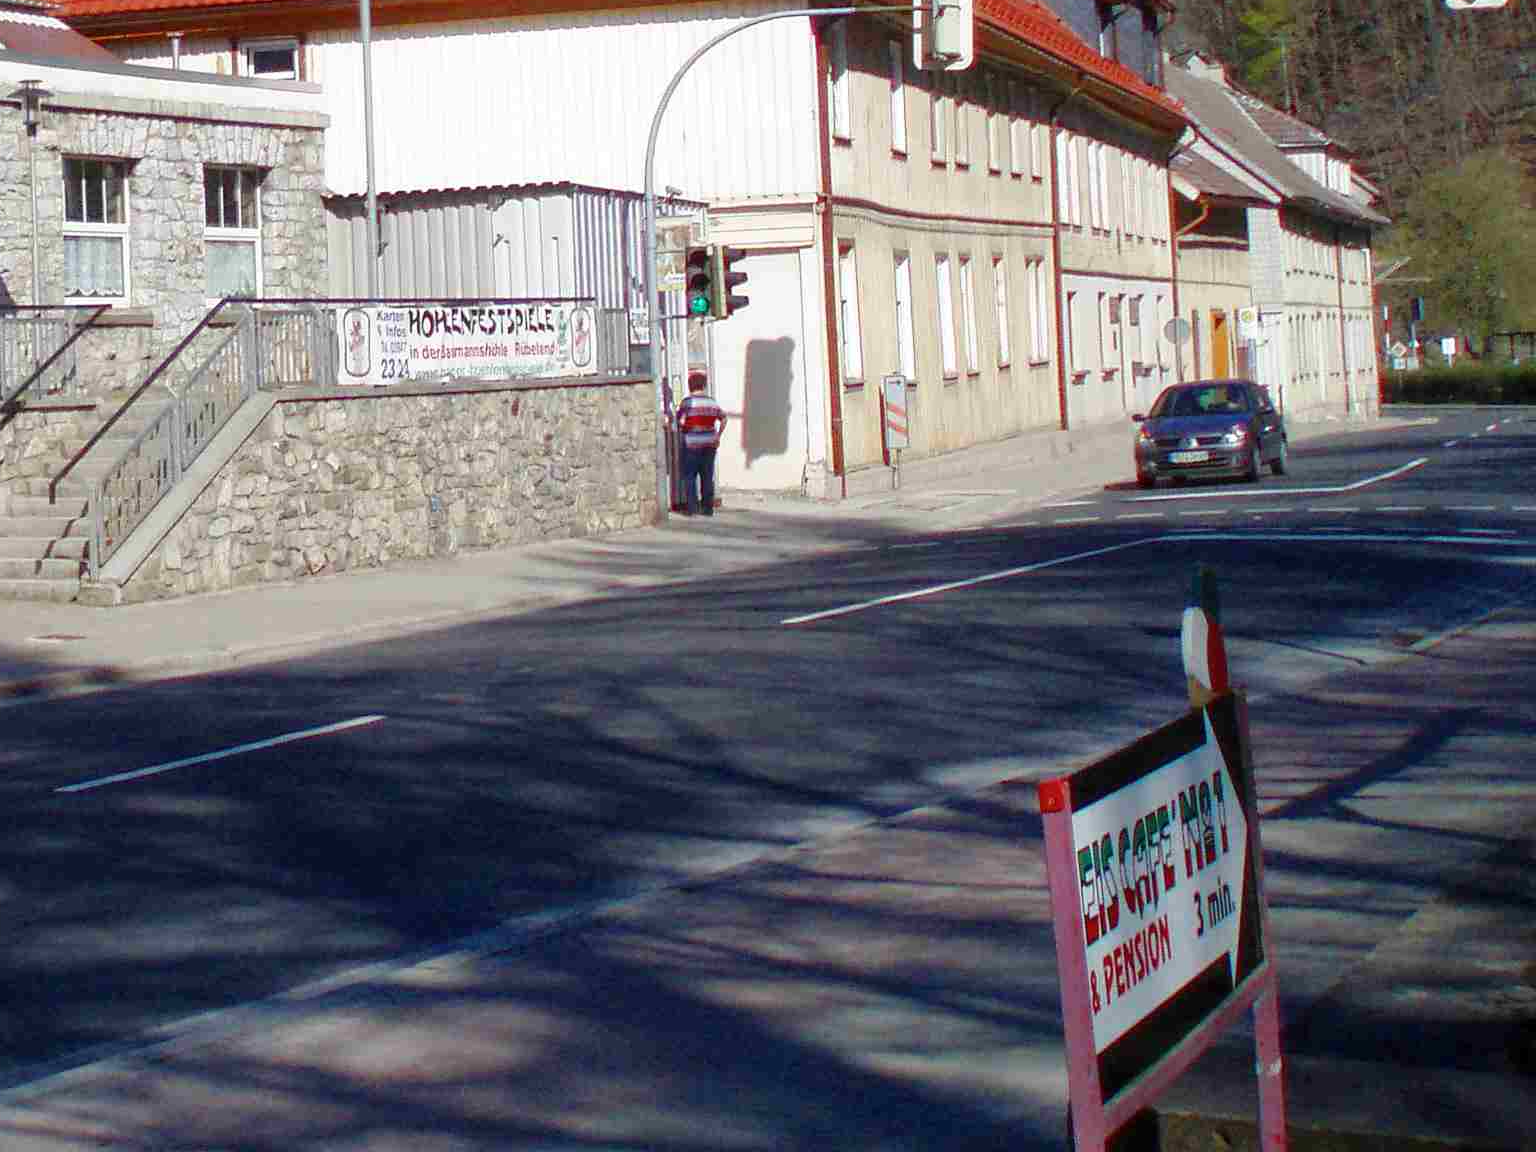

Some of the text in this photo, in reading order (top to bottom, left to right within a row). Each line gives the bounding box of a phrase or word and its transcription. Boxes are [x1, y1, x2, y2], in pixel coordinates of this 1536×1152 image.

[1077, 832, 1119, 947] EIS
[1193, 876, 1236, 937] 3 min.
[1090, 914, 1172, 1015] & PENSION
